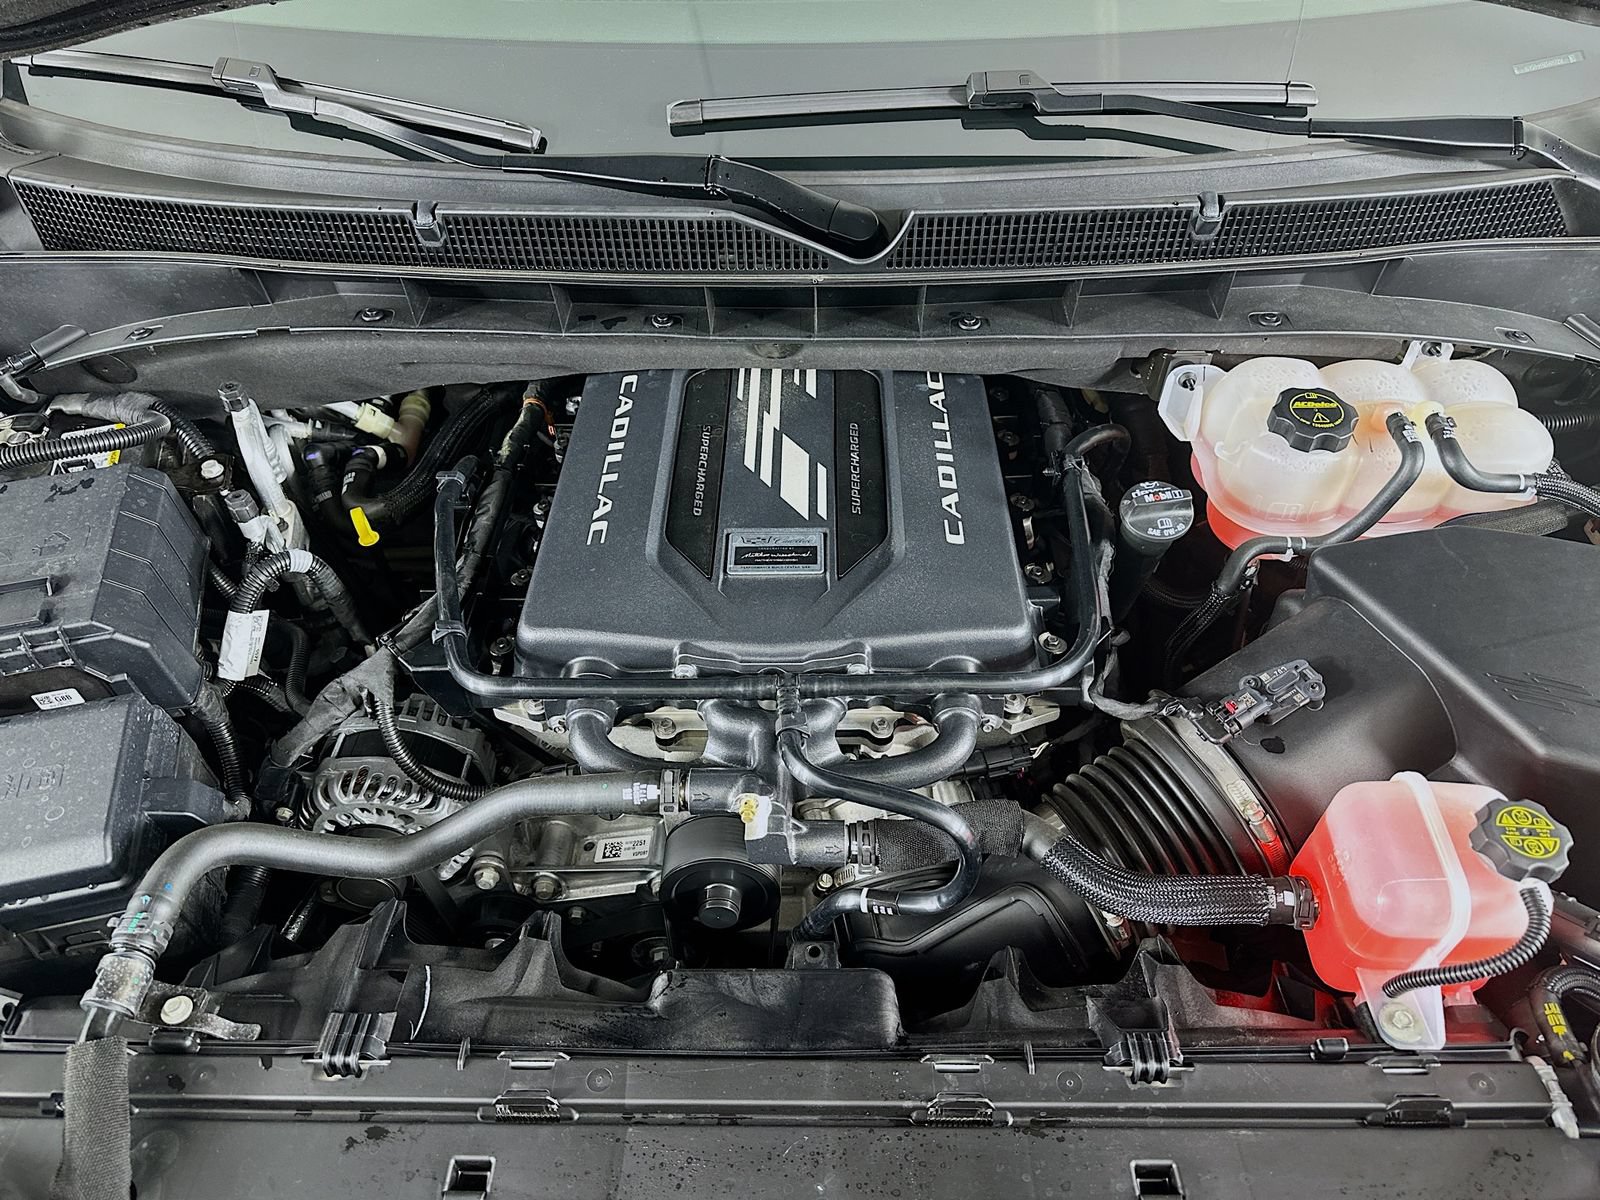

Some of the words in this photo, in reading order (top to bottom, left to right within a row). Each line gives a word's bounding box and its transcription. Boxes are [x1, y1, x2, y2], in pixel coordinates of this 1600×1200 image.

[586, 374, 639, 546] CADILLAC
[693, 425, 712, 516] SUPERCHARGED
[849, 422, 862, 515] SUPERCHARGED
[926, 371, 965, 545] CADILLAC
[1143, 490, 1172, 503] Mobil
